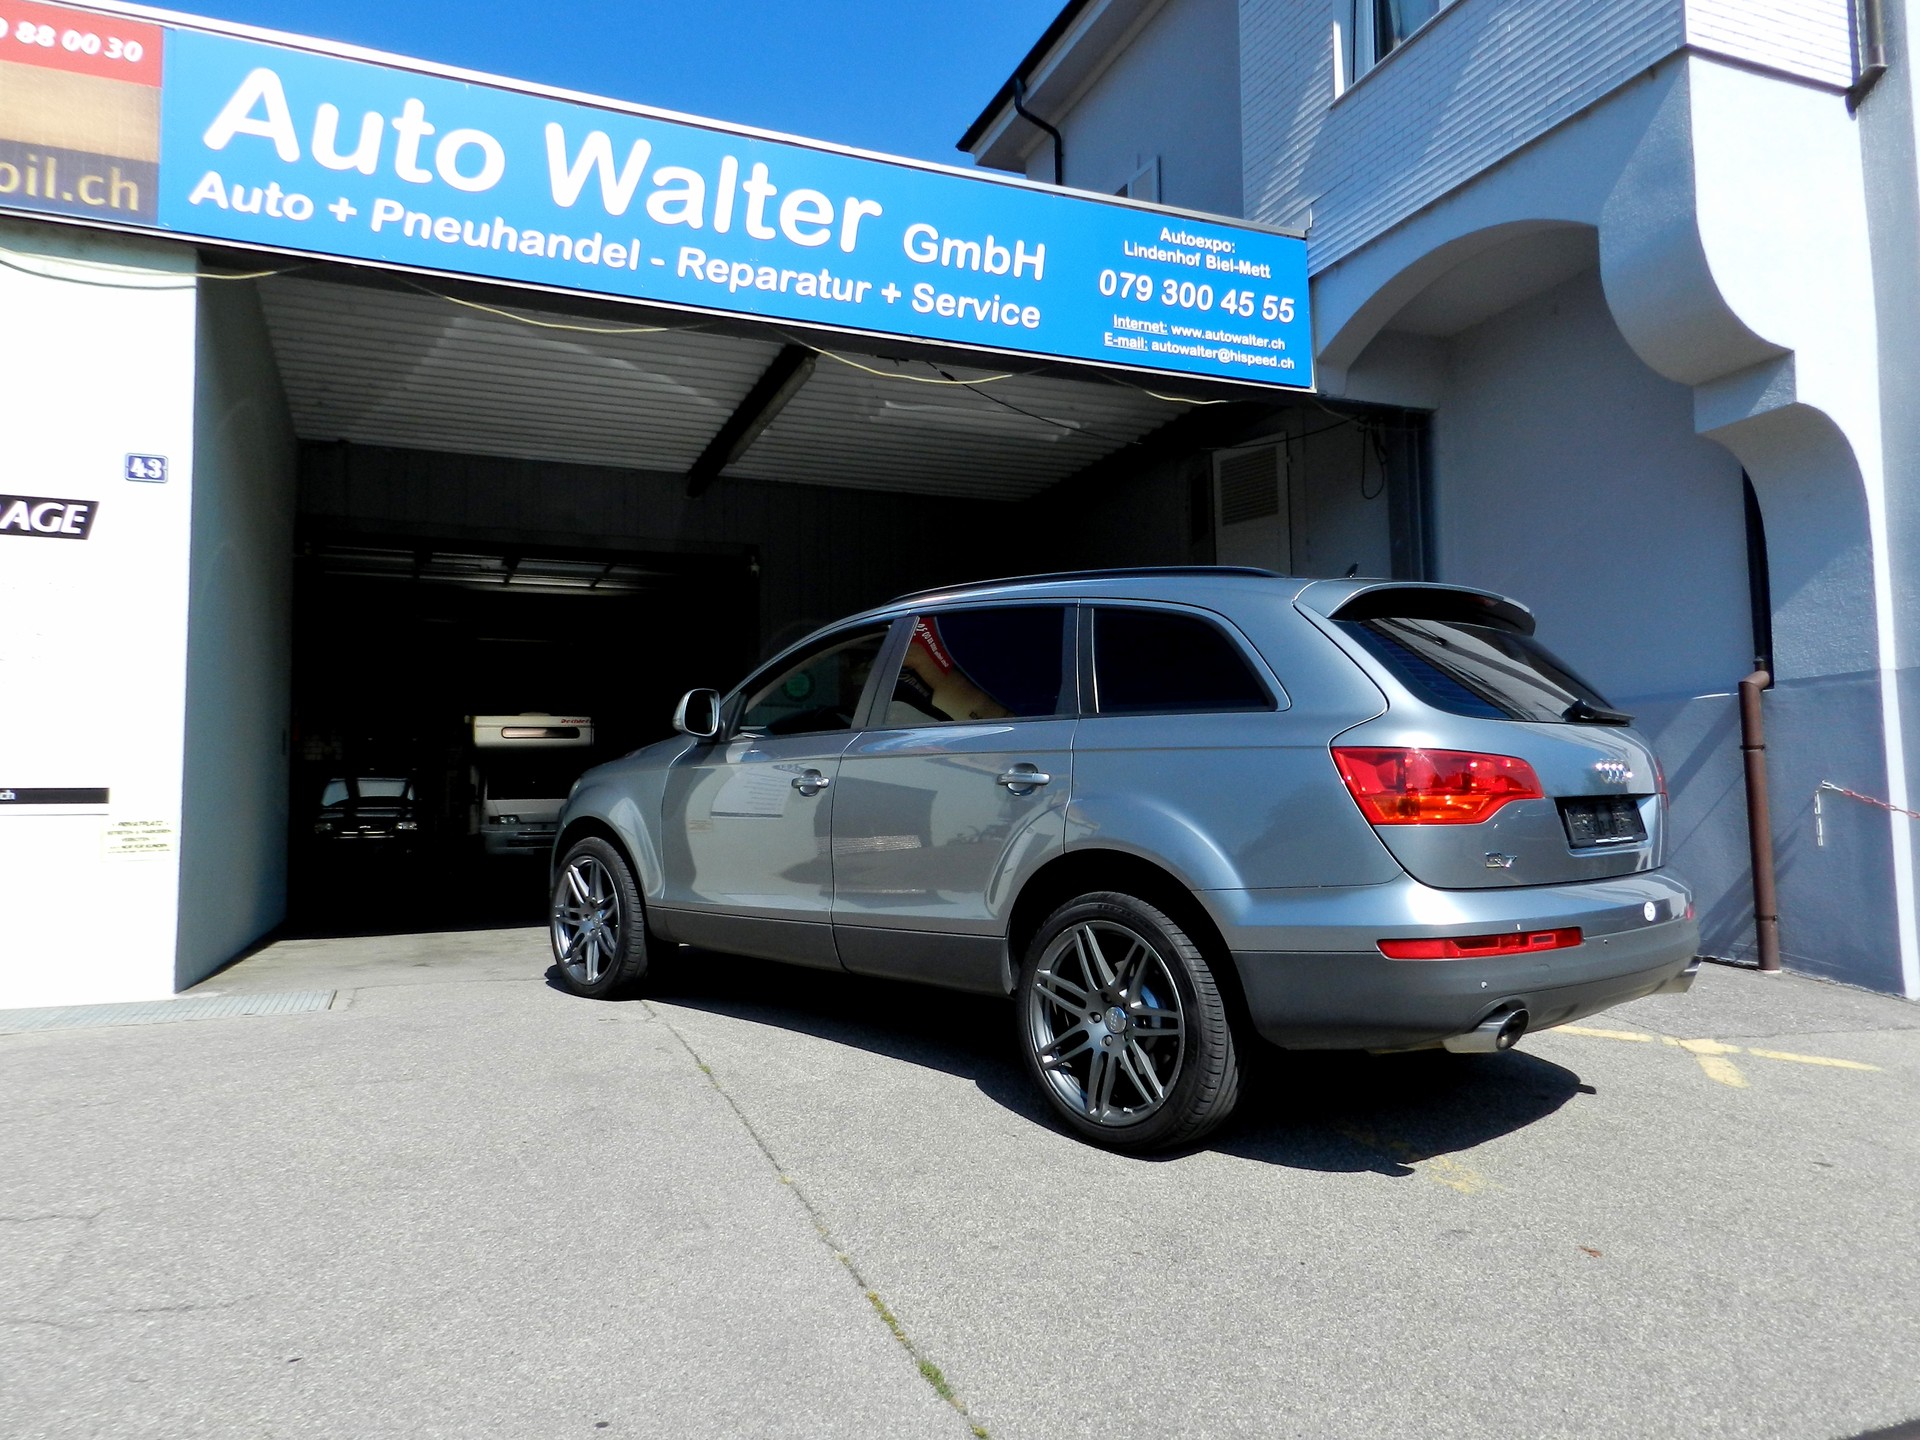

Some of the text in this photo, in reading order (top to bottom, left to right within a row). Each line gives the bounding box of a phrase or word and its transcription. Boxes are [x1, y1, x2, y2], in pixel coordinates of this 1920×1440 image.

[14, 21, 56, 48] 88
[61, 29, 102, 55] 00
[103, 36, 144, 63] 30
[202, 66, 1046, 281] Auto Walter GmbH
[188, 170, 1042, 329] Auto + Pneuhandel - Reparatur + Service
[1123, 240, 1272, 279] Lindenhof Biel-Mett
[1159, 226, 1236, 254] Autoexpo:
[1099, 269, 1295, 323] 079 300 45 55
[1104, 332, 1295, 369] E-mail: autowalter@hispeed.ch
[1113, 314, 1286, 350] Internet: www.autowalter.ch
[129, 457, 163, 479] 43
